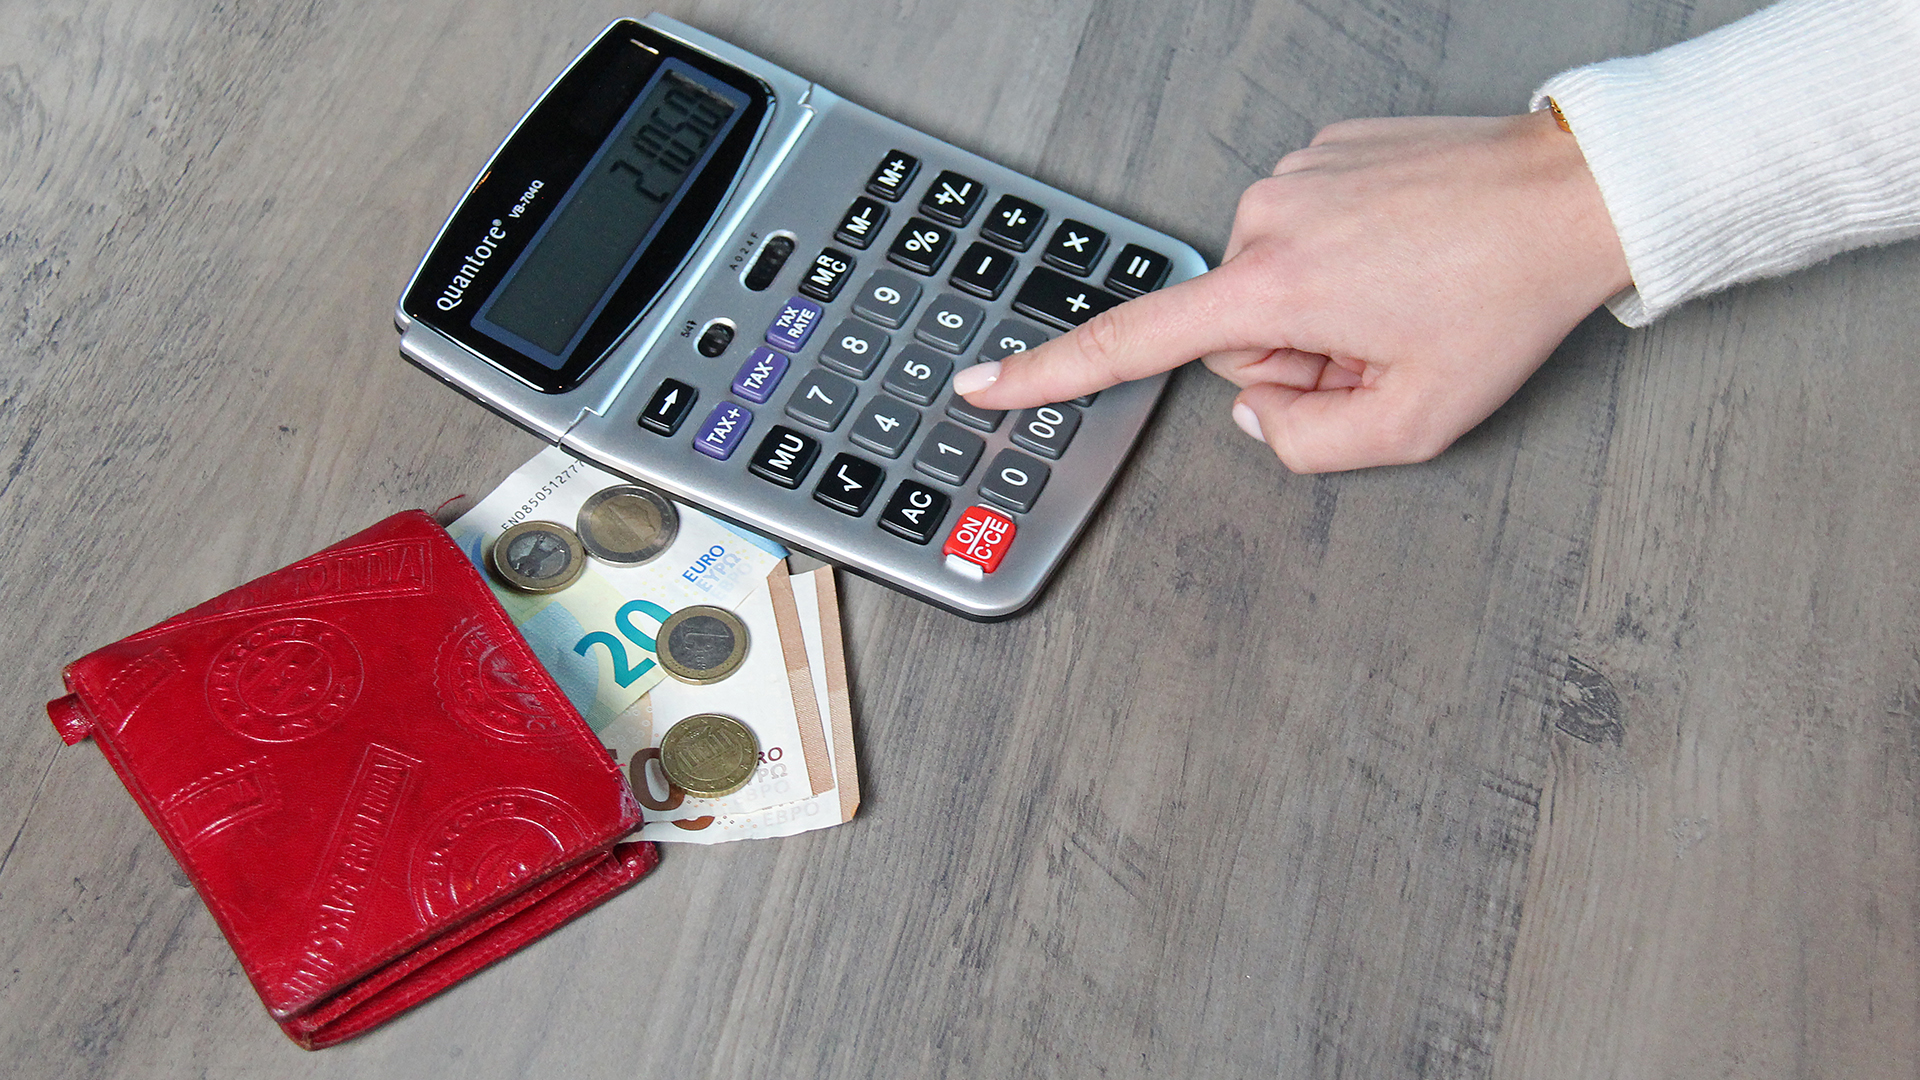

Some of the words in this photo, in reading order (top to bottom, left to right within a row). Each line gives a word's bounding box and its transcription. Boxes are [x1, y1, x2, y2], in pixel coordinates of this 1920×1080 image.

[878, 159, 906, 187] M+
[508, 180, 545, 219] VB-704Q
[904, 230, 940, 253] %
[873, 285, 901, 305] 9
[776, 306, 799, 330] TAX
[790, 308, 816, 339] RATE
[936, 310, 964, 329] 6
[841, 336, 869, 354] 8
[999, 336, 1027, 354] 3
[903, 360, 932, 380] 5
[806, 385, 834, 409] 7
[706, 407, 741, 445] TAX+
[874, 412, 901, 433] 4
[1028, 406, 1064, 440] 00
[768, 434, 804, 471] MU
[937, 441, 964, 458] 1
[1001, 468, 1029, 487] 0
[901, 490, 933, 525] AC
[956, 516, 983, 544] ON
[682, 545, 725, 583] EURO
[573, 599, 673, 689] 20
[757, 746, 783, 766] RO
